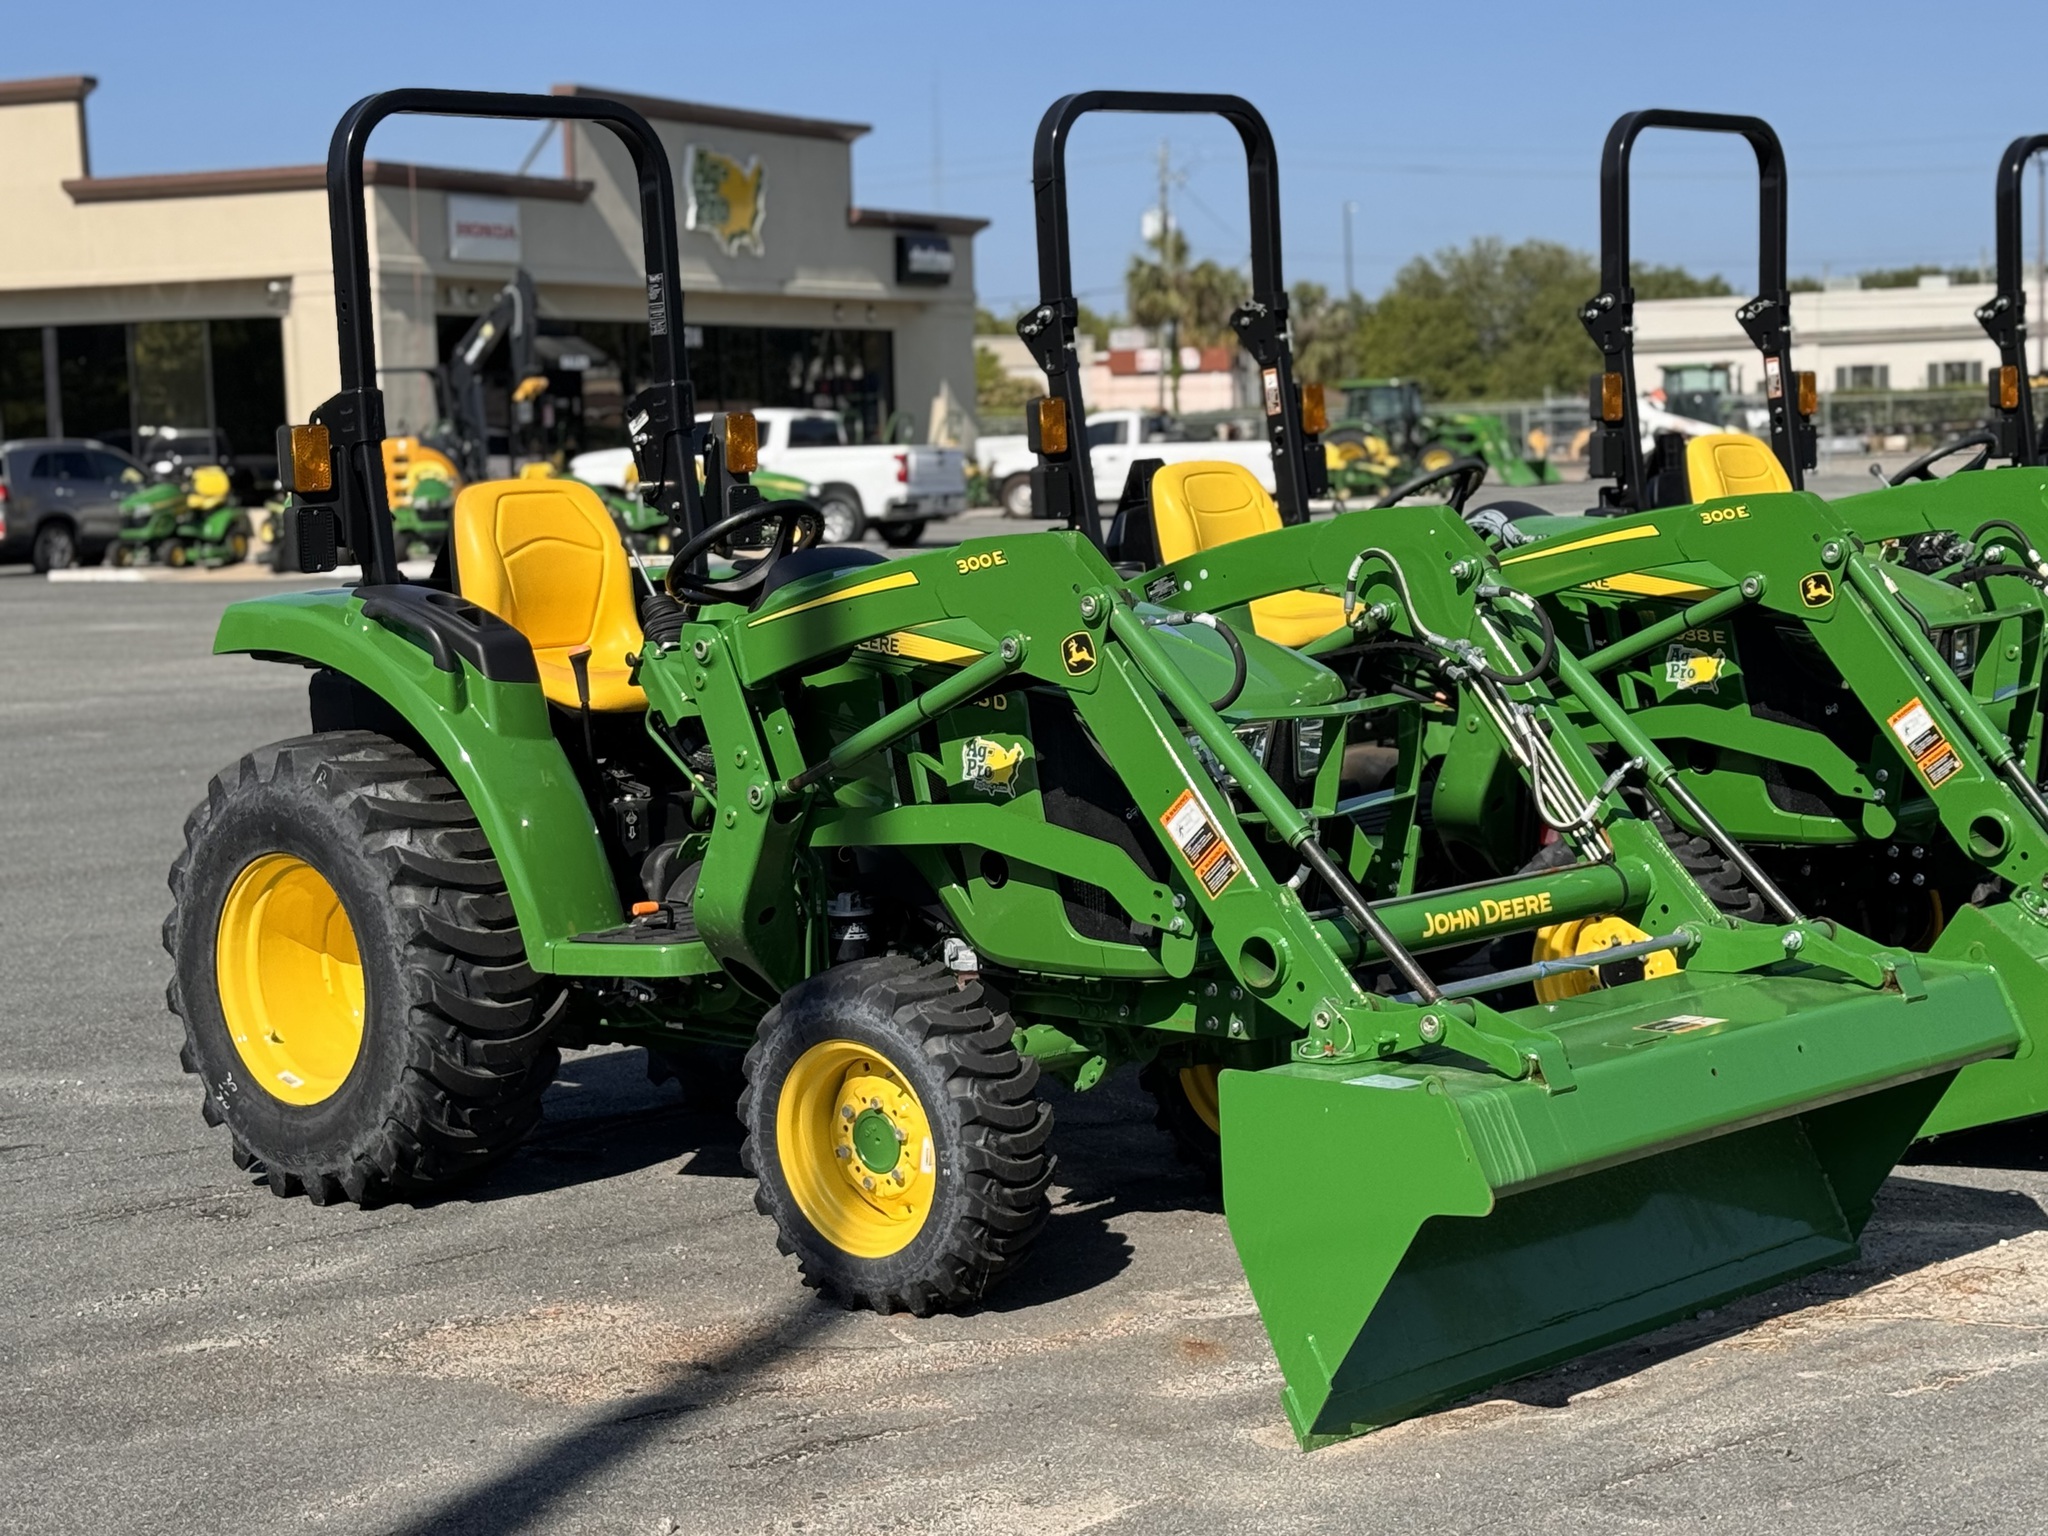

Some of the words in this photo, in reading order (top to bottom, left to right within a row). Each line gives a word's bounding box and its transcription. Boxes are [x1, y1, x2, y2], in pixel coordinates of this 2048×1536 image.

[1670, 663, 1696, 679] Pro
[966, 758, 993, 779] Pro
[1422, 906, 1480, 938] JOHN
[1480, 891, 1553, 925] DEERE
